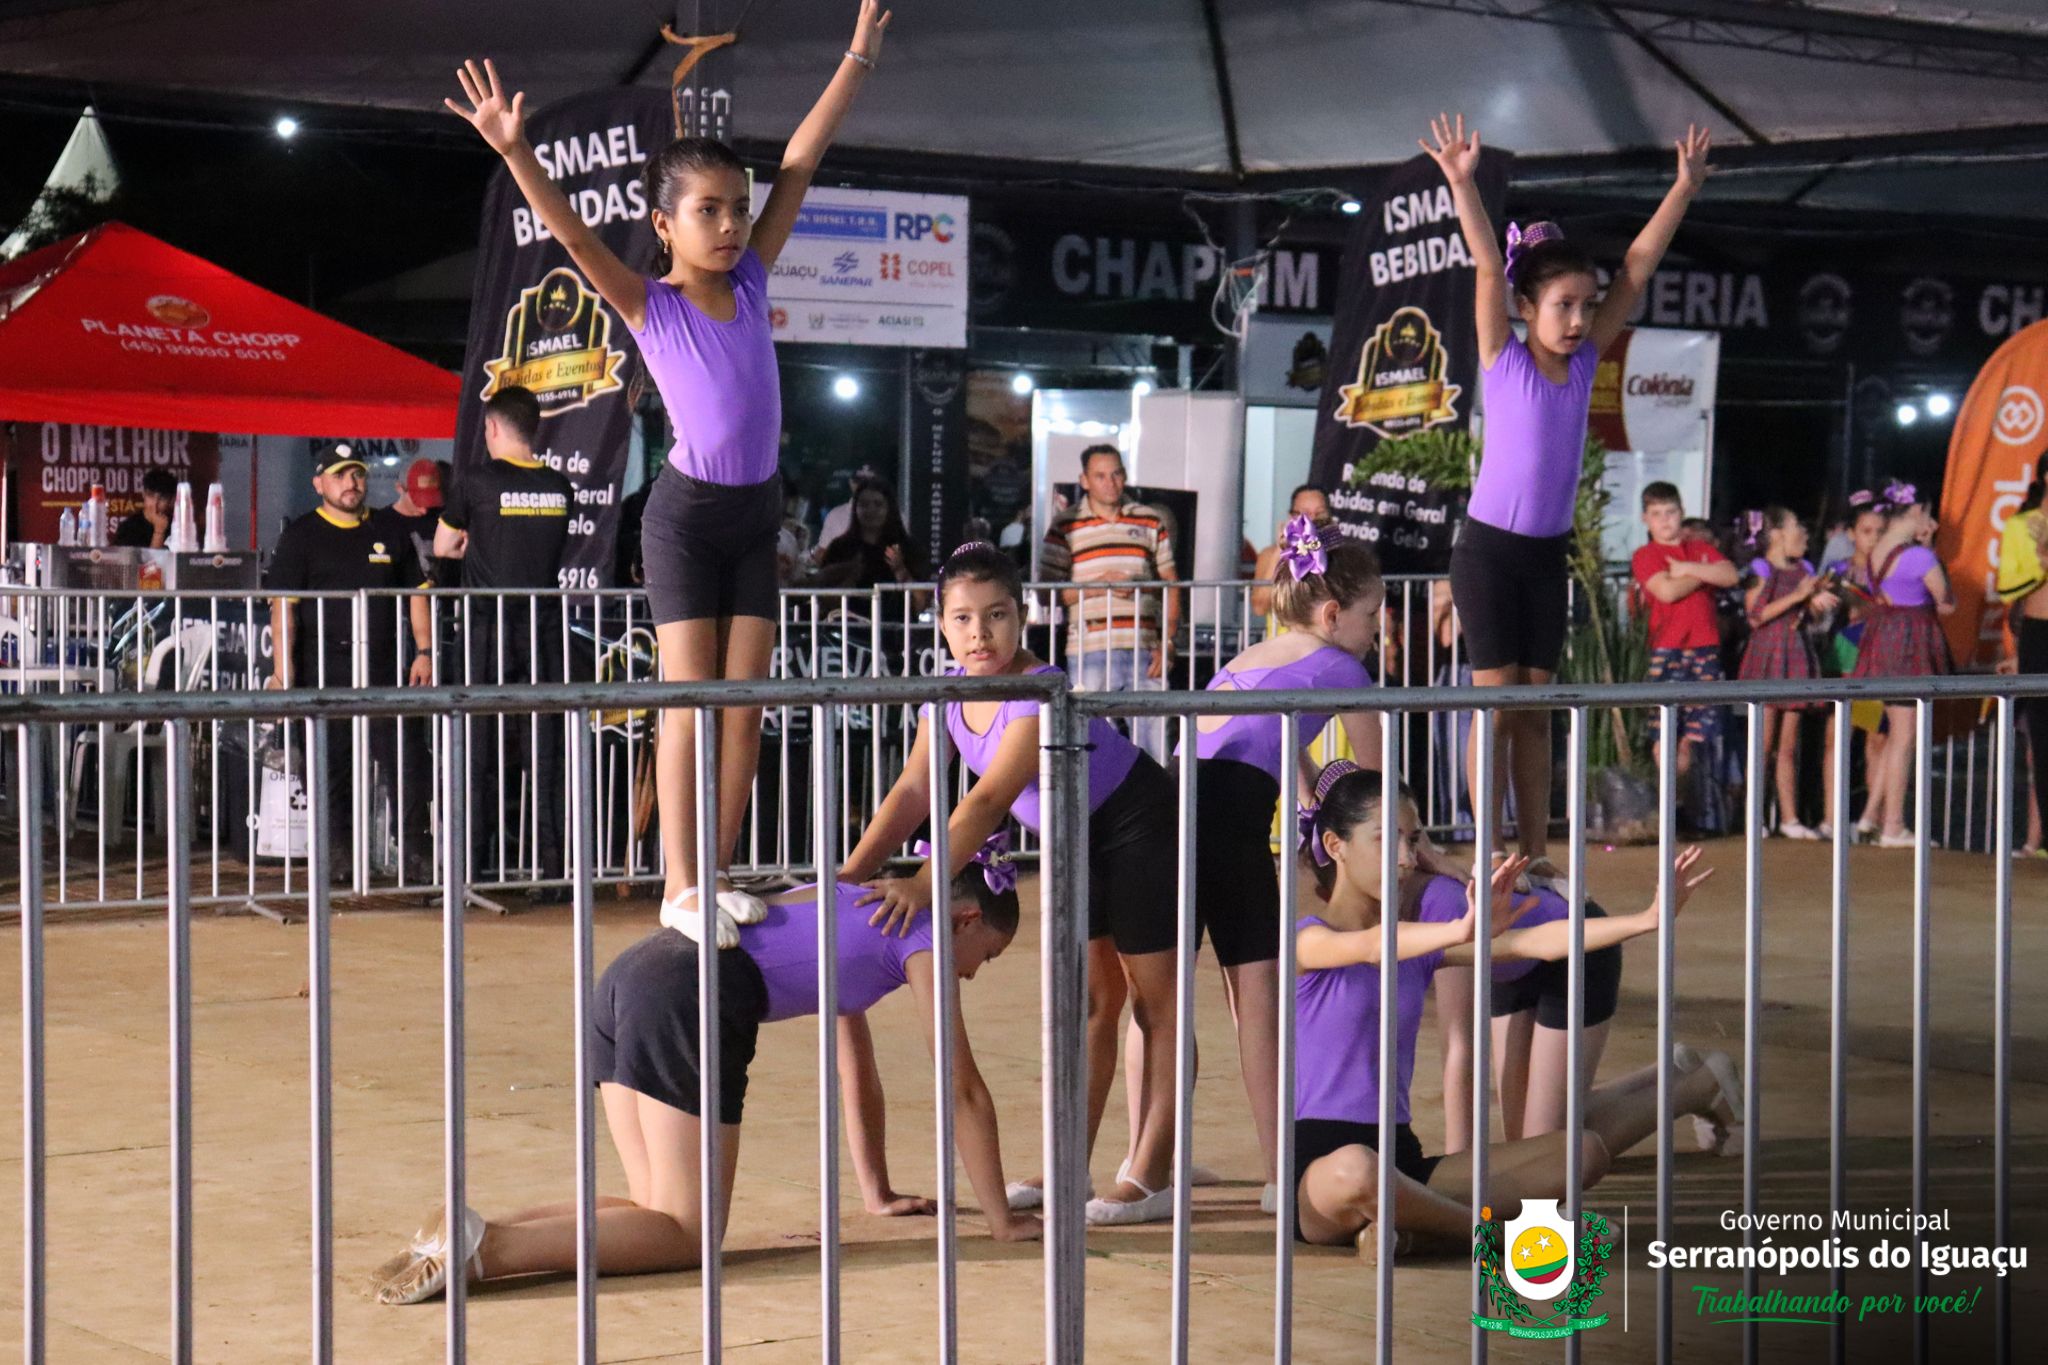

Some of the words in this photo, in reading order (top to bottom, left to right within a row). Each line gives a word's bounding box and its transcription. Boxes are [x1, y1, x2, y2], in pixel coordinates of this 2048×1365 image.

[533, 123, 648, 181] SMAEL
[512, 179, 648, 248] BEIDAS
[1383, 184, 1459, 235] ISMA
[894, 211, 955, 243] RPC
[769, 264, 818, 280] GUAÇU
[907, 259, 955, 278] COPEL
[81, 317, 208, 344] PLANETA
[212, 330, 302, 348] CHOPP
[526, 333, 582, 357] ISMAEL
[556, 360, 601, 378] Eventos
[1375, 367, 1427, 387] ISMAEL
[70, 425, 191, 467] MELHOR
[566, 450, 591, 474] de
[41, 466, 101, 494] CHOPP
[105, 468, 129, 494] DO
[1404, 500, 1447, 523] Geral
[567, 512, 596, 536] elo
